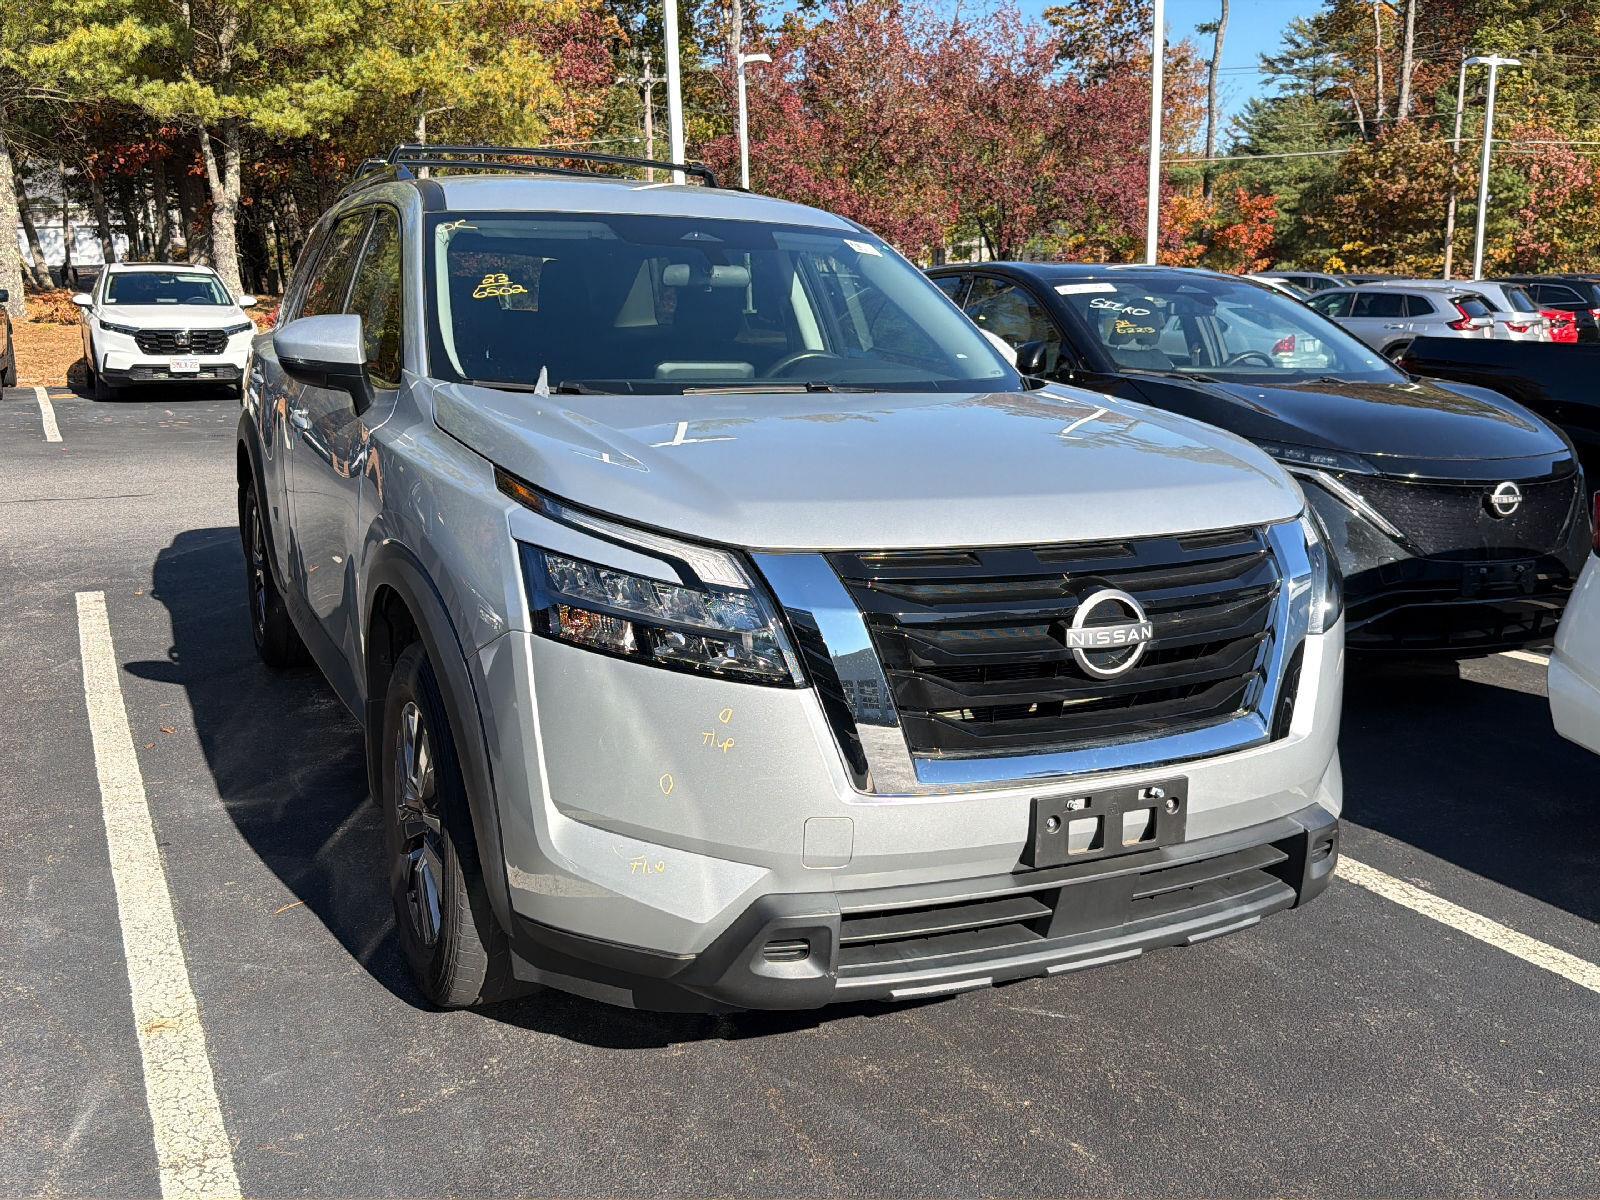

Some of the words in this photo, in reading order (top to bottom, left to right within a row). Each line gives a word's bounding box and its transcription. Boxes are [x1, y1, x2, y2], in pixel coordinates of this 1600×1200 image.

[482, 273, 508, 284] 23
[473, 284, 527, 298] 6502
[1492, 495, 1522, 503] NISSAN
[1069, 625, 1152, 646] NISSAN
